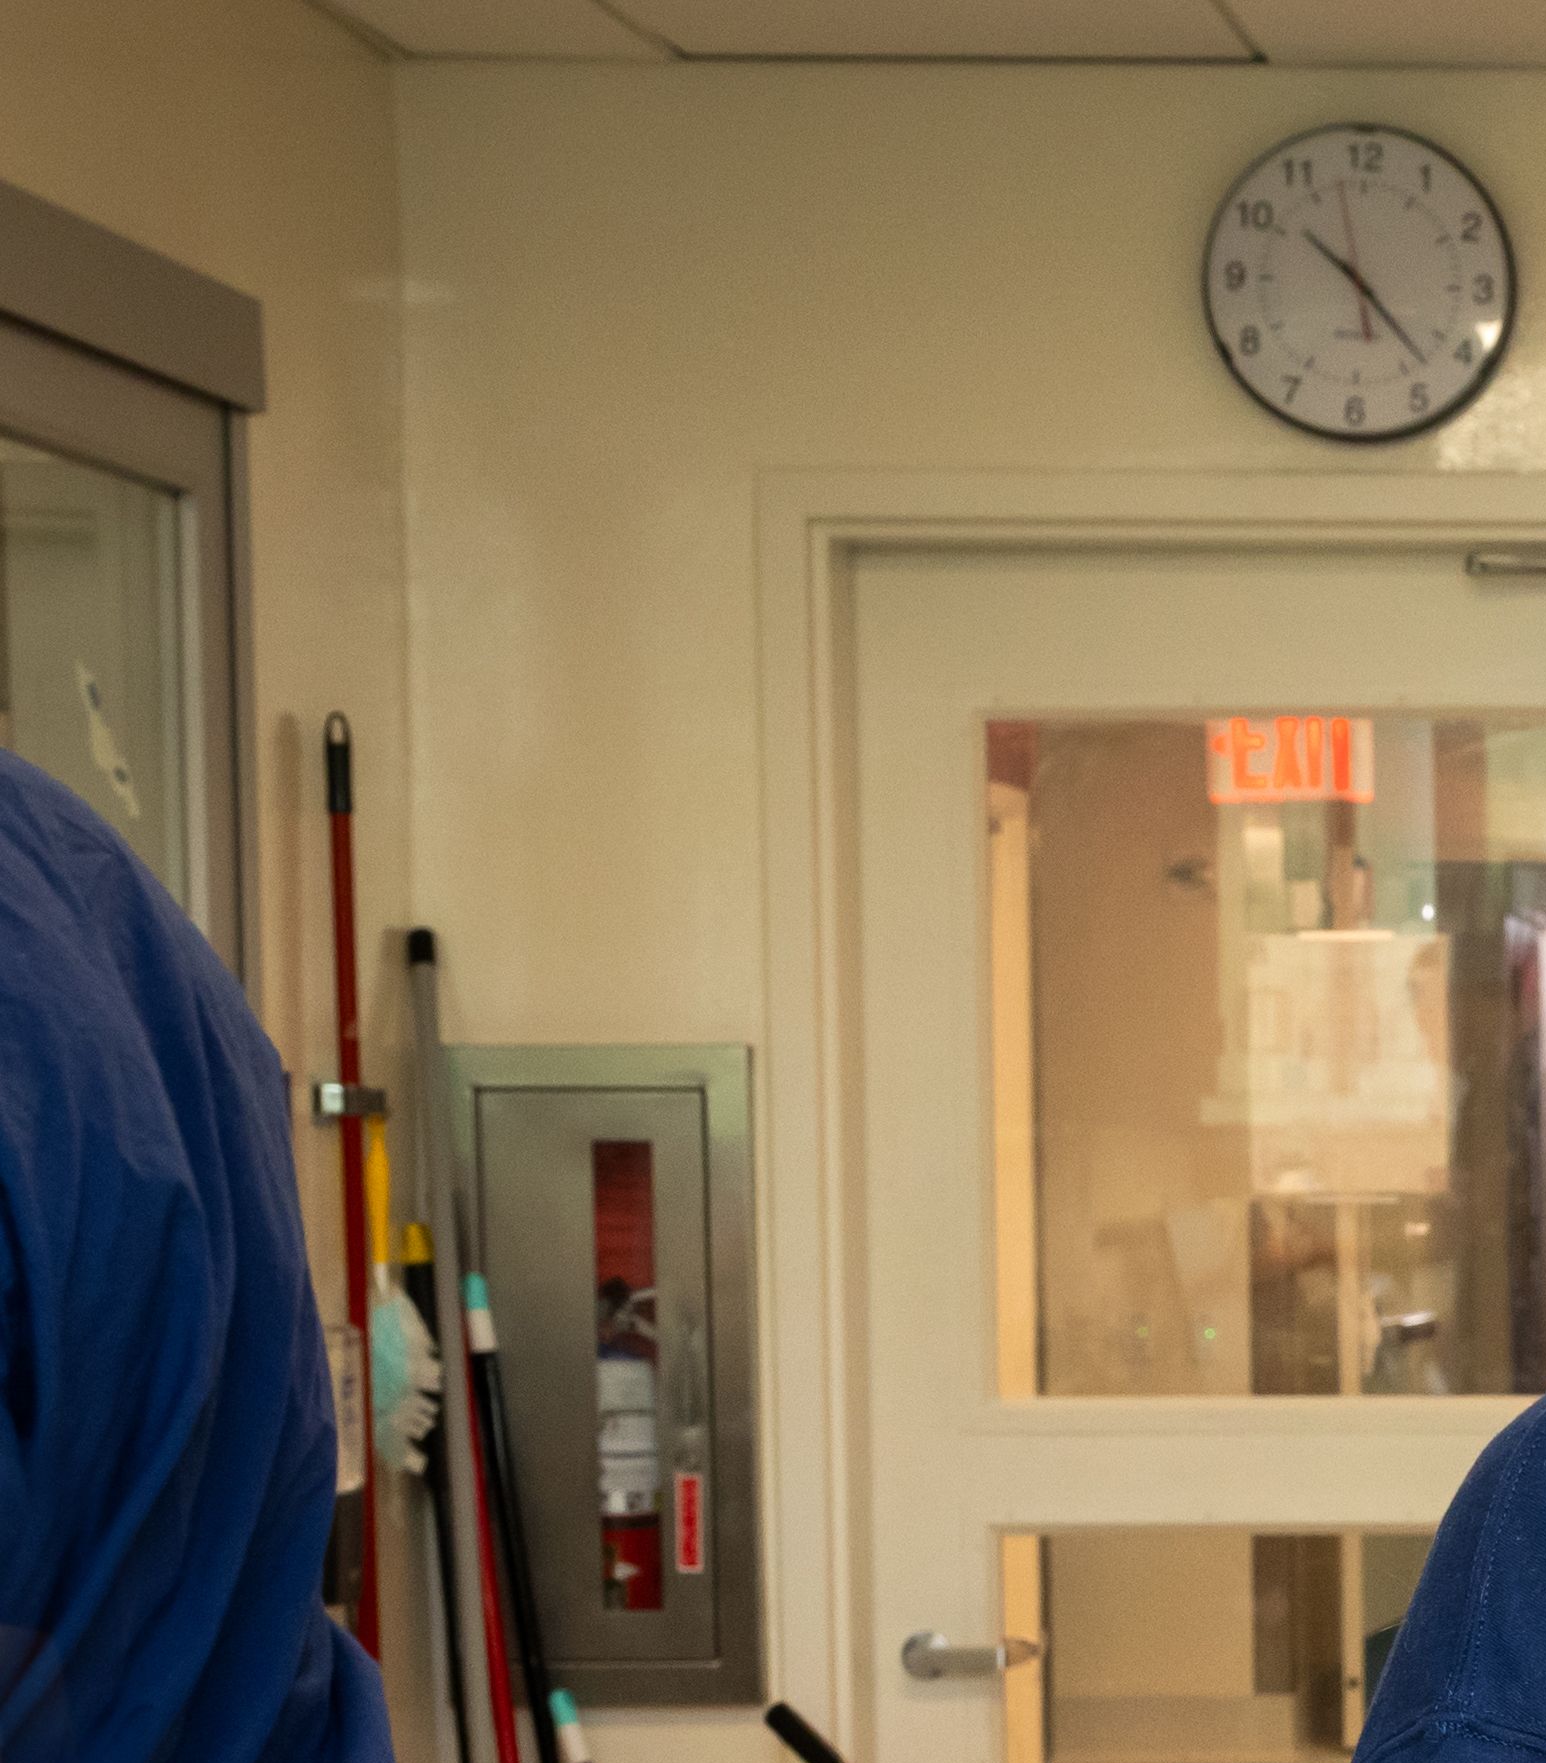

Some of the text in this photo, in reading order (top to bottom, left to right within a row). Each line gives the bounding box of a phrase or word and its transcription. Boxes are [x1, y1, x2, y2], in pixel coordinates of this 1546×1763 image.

[1282, 158, 1313, 187] 11
[1349, 142, 1384, 173] 12
[1420, 163, 1432, 192] 1
[1237, 200, 1274, 231] 10
[1460, 211, 1483, 243] 2
[1224, 260, 1246, 292] 9
[1473, 273, 1495, 305] 3
[1281, 374, 1302, 404] 7
[1409, 382, 1430, 413] 5
[1343, 395, 1366, 427] 6
